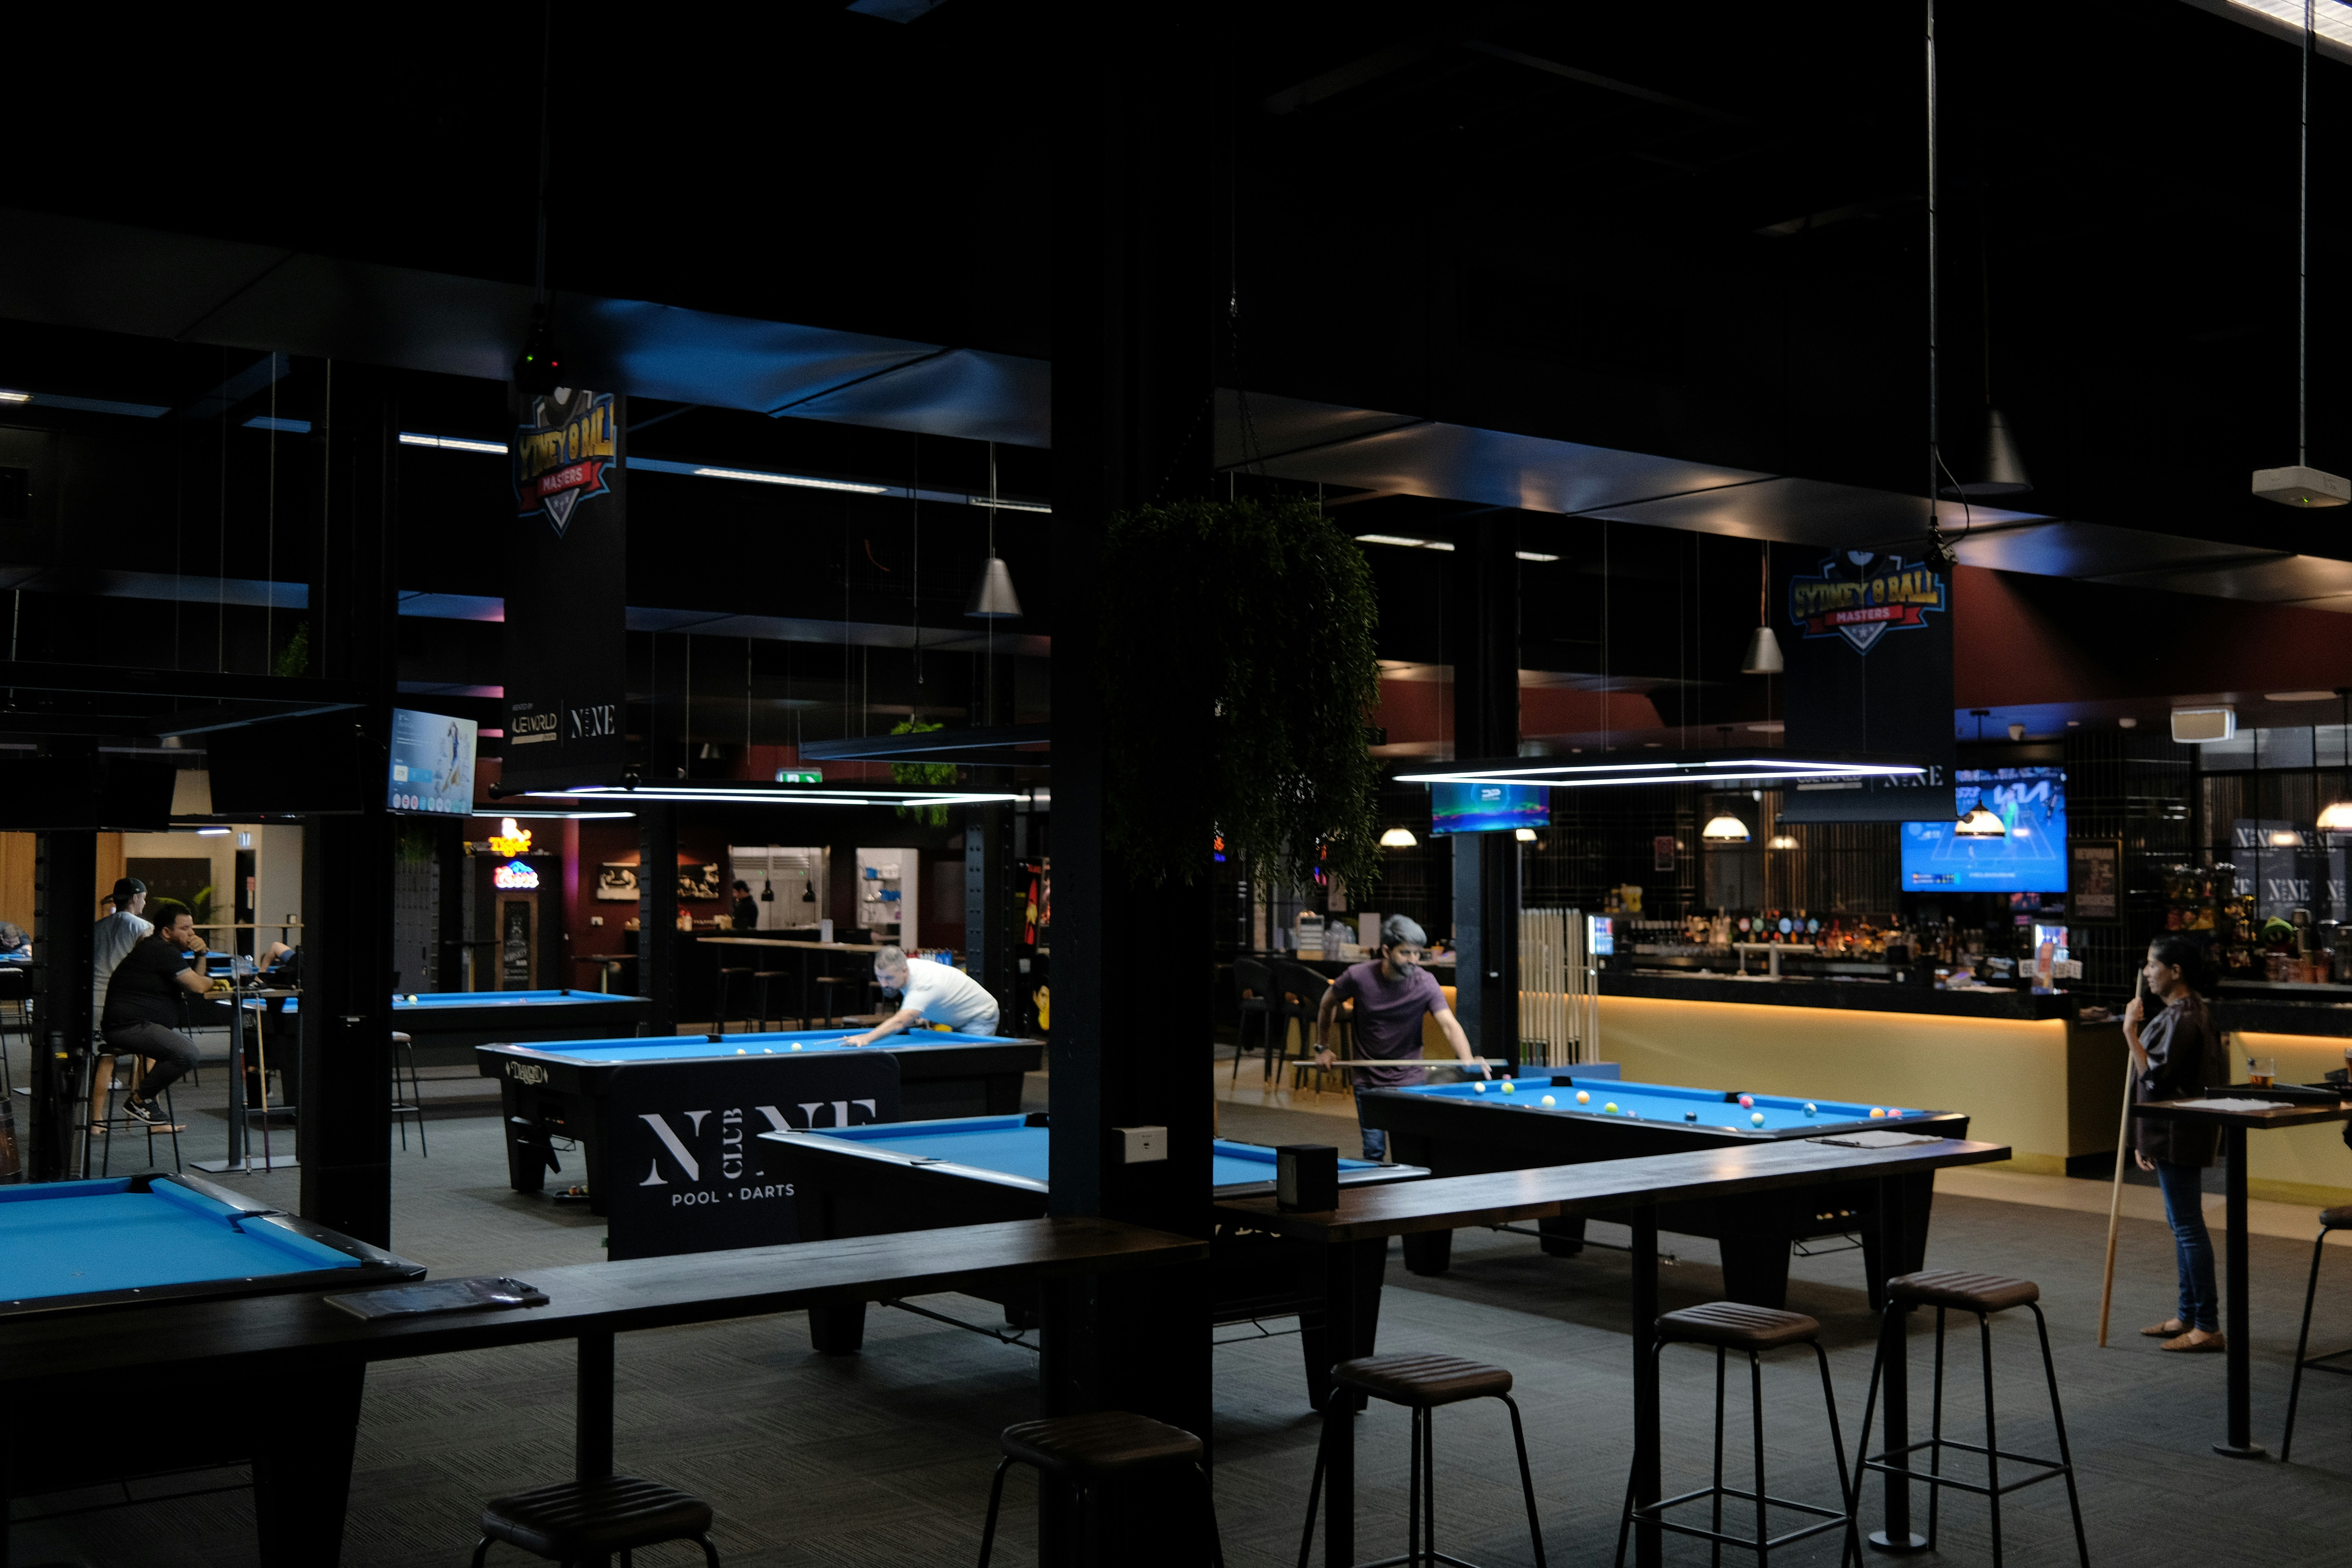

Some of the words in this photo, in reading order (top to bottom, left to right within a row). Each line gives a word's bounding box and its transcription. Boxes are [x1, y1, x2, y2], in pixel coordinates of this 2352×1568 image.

[1872, 579, 1885, 603] 8
[1887, 569, 1938, 604] BALL
[1836, 607, 1890, 623] MASTERS
[723, 1107, 743, 1180] CLUB
[672, 1191, 720, 1206] POOL
[740, 1183, 795, 1201] DARTS
